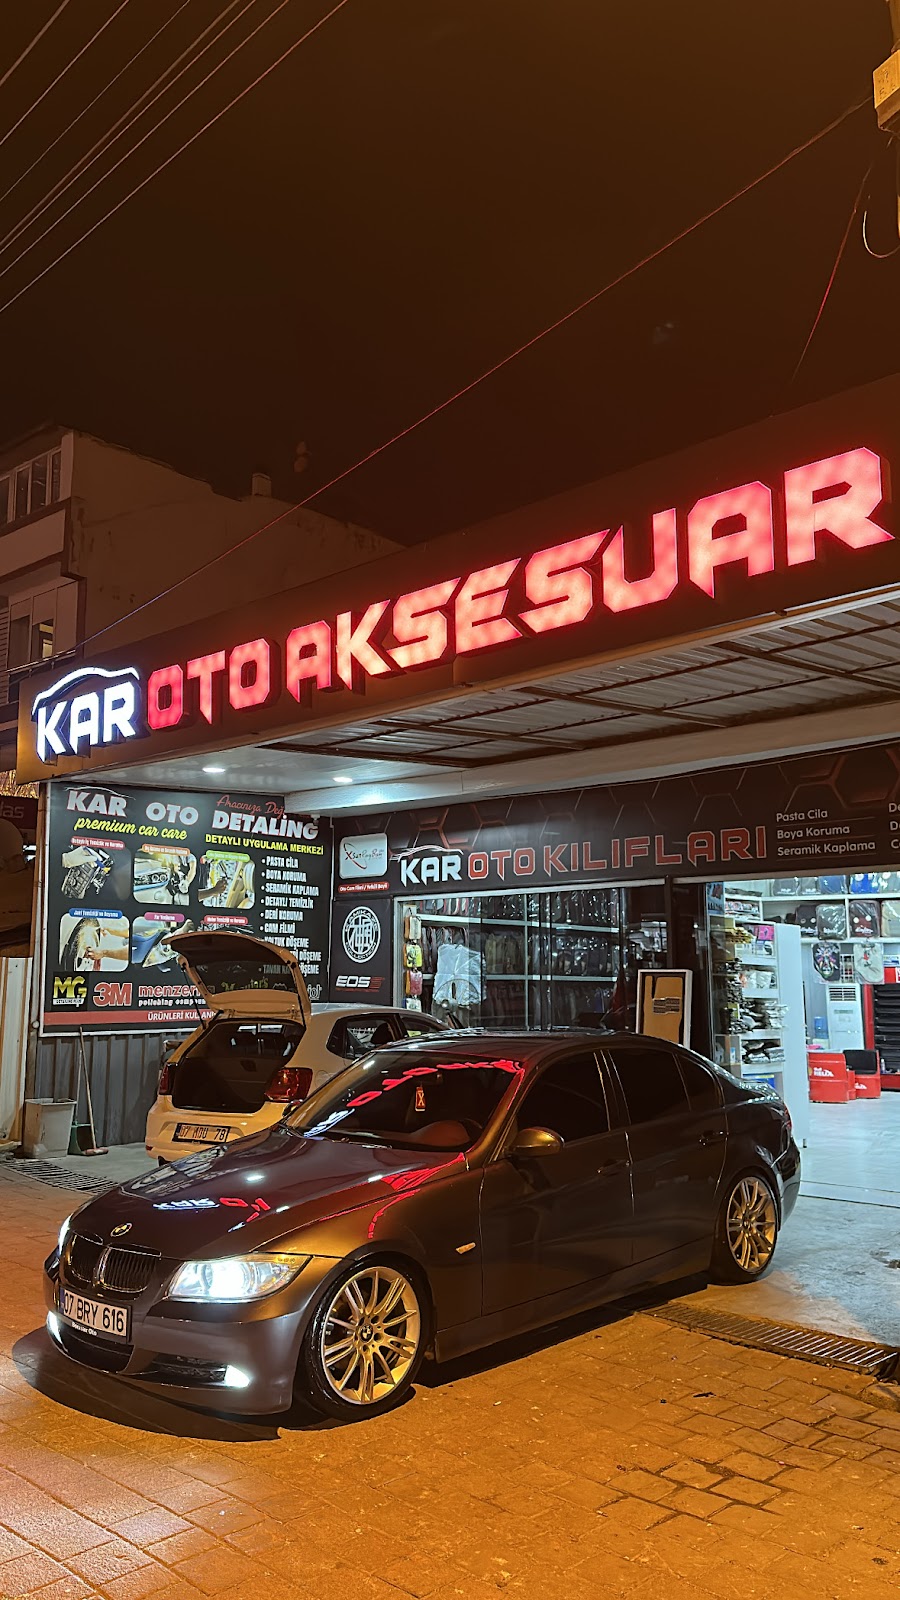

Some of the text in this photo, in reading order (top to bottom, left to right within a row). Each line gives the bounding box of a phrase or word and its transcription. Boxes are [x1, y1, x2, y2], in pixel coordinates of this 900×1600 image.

[36, 446, 896, 764] KAR OTO AKSESUAR
[66, 790, 127, 818] KAR
[145, 802, 199, 826] OTO
[776, 809, 828, 822] Pasta Cila
[74, 817, 136, 835] premium
[138, 824, 159, 837] car
[160, 827, 187, 840] care
[777, 826, 850, 840] Boya Koruma
[205, 834, 324, 855] DETAYLI UYGULAMA MERKEZİ
[777, 841, 876, 856] Seramik Kaplama
[266, 856, 299, 868] PASTA CİLA
[399, 825, 766, 887] KAR OTO KILIFLARI
[265, 869, 307, 882] BOYA KORUMA
[265, 882, 320, 896] SERAMİK KAPLAMA
[264, 896, 314, 909] DETAYLI TEMİZLİK
[264, 908, 304, 921] DERİ KORUMA
[264, 922, 296, 934] CAM FİLMİ
[285, 935, 310, 950] DÖŞEME
[299, 949, 322, 964] DÖŞEME
[52, 975, 88, 999] MG
[92, 981, 133, 1007] 3M
[138, 998, 173, 1007] polishing
[147, 1011, 184, 1021] ÜRÜNLERİ
[213, 1128, 226, 1141] 78
[64, 1292, 74, 1315] 07
[76, 1298, 98, 1326] BRY
[102, 1307, 124, 1333] 616
